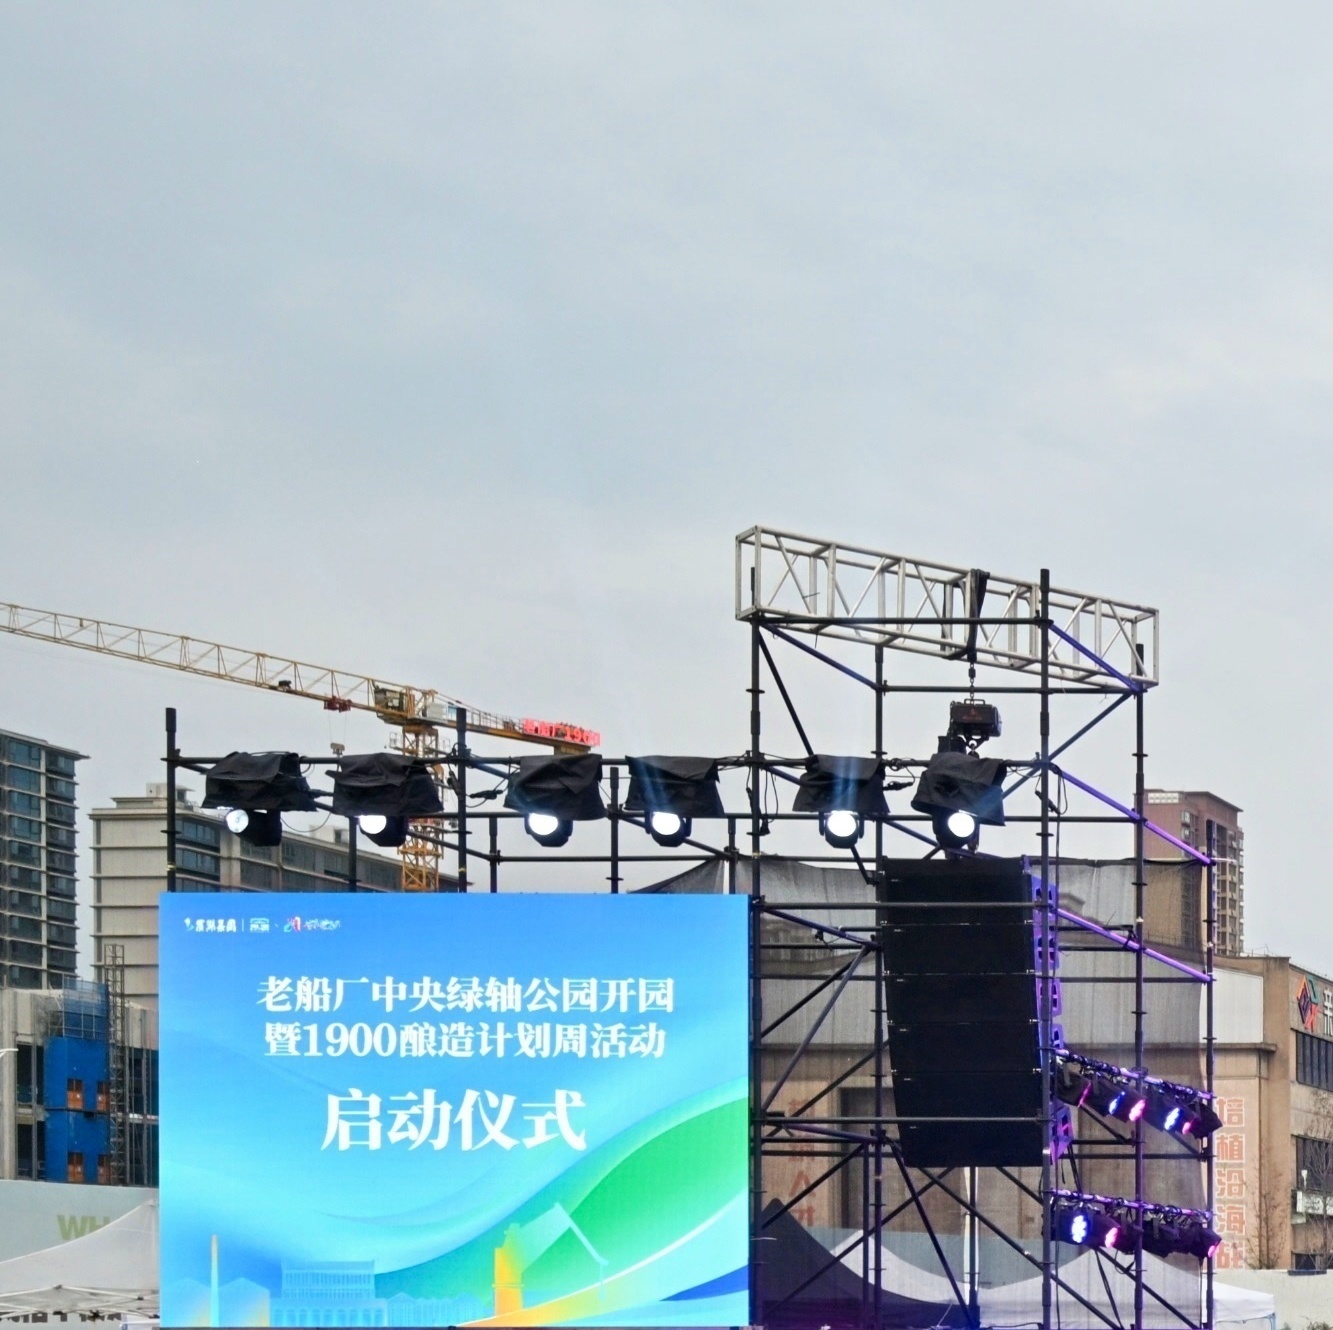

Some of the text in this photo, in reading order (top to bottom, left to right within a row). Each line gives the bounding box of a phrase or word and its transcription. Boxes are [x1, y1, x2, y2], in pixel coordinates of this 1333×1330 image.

[257, 976, 675, 1013] 老船厂中央绿轴公园开园
[264, 1022, 666, 1059] 暨1900酿造计划周活动
[320, 1088, 586, 1152] 启动仪式
